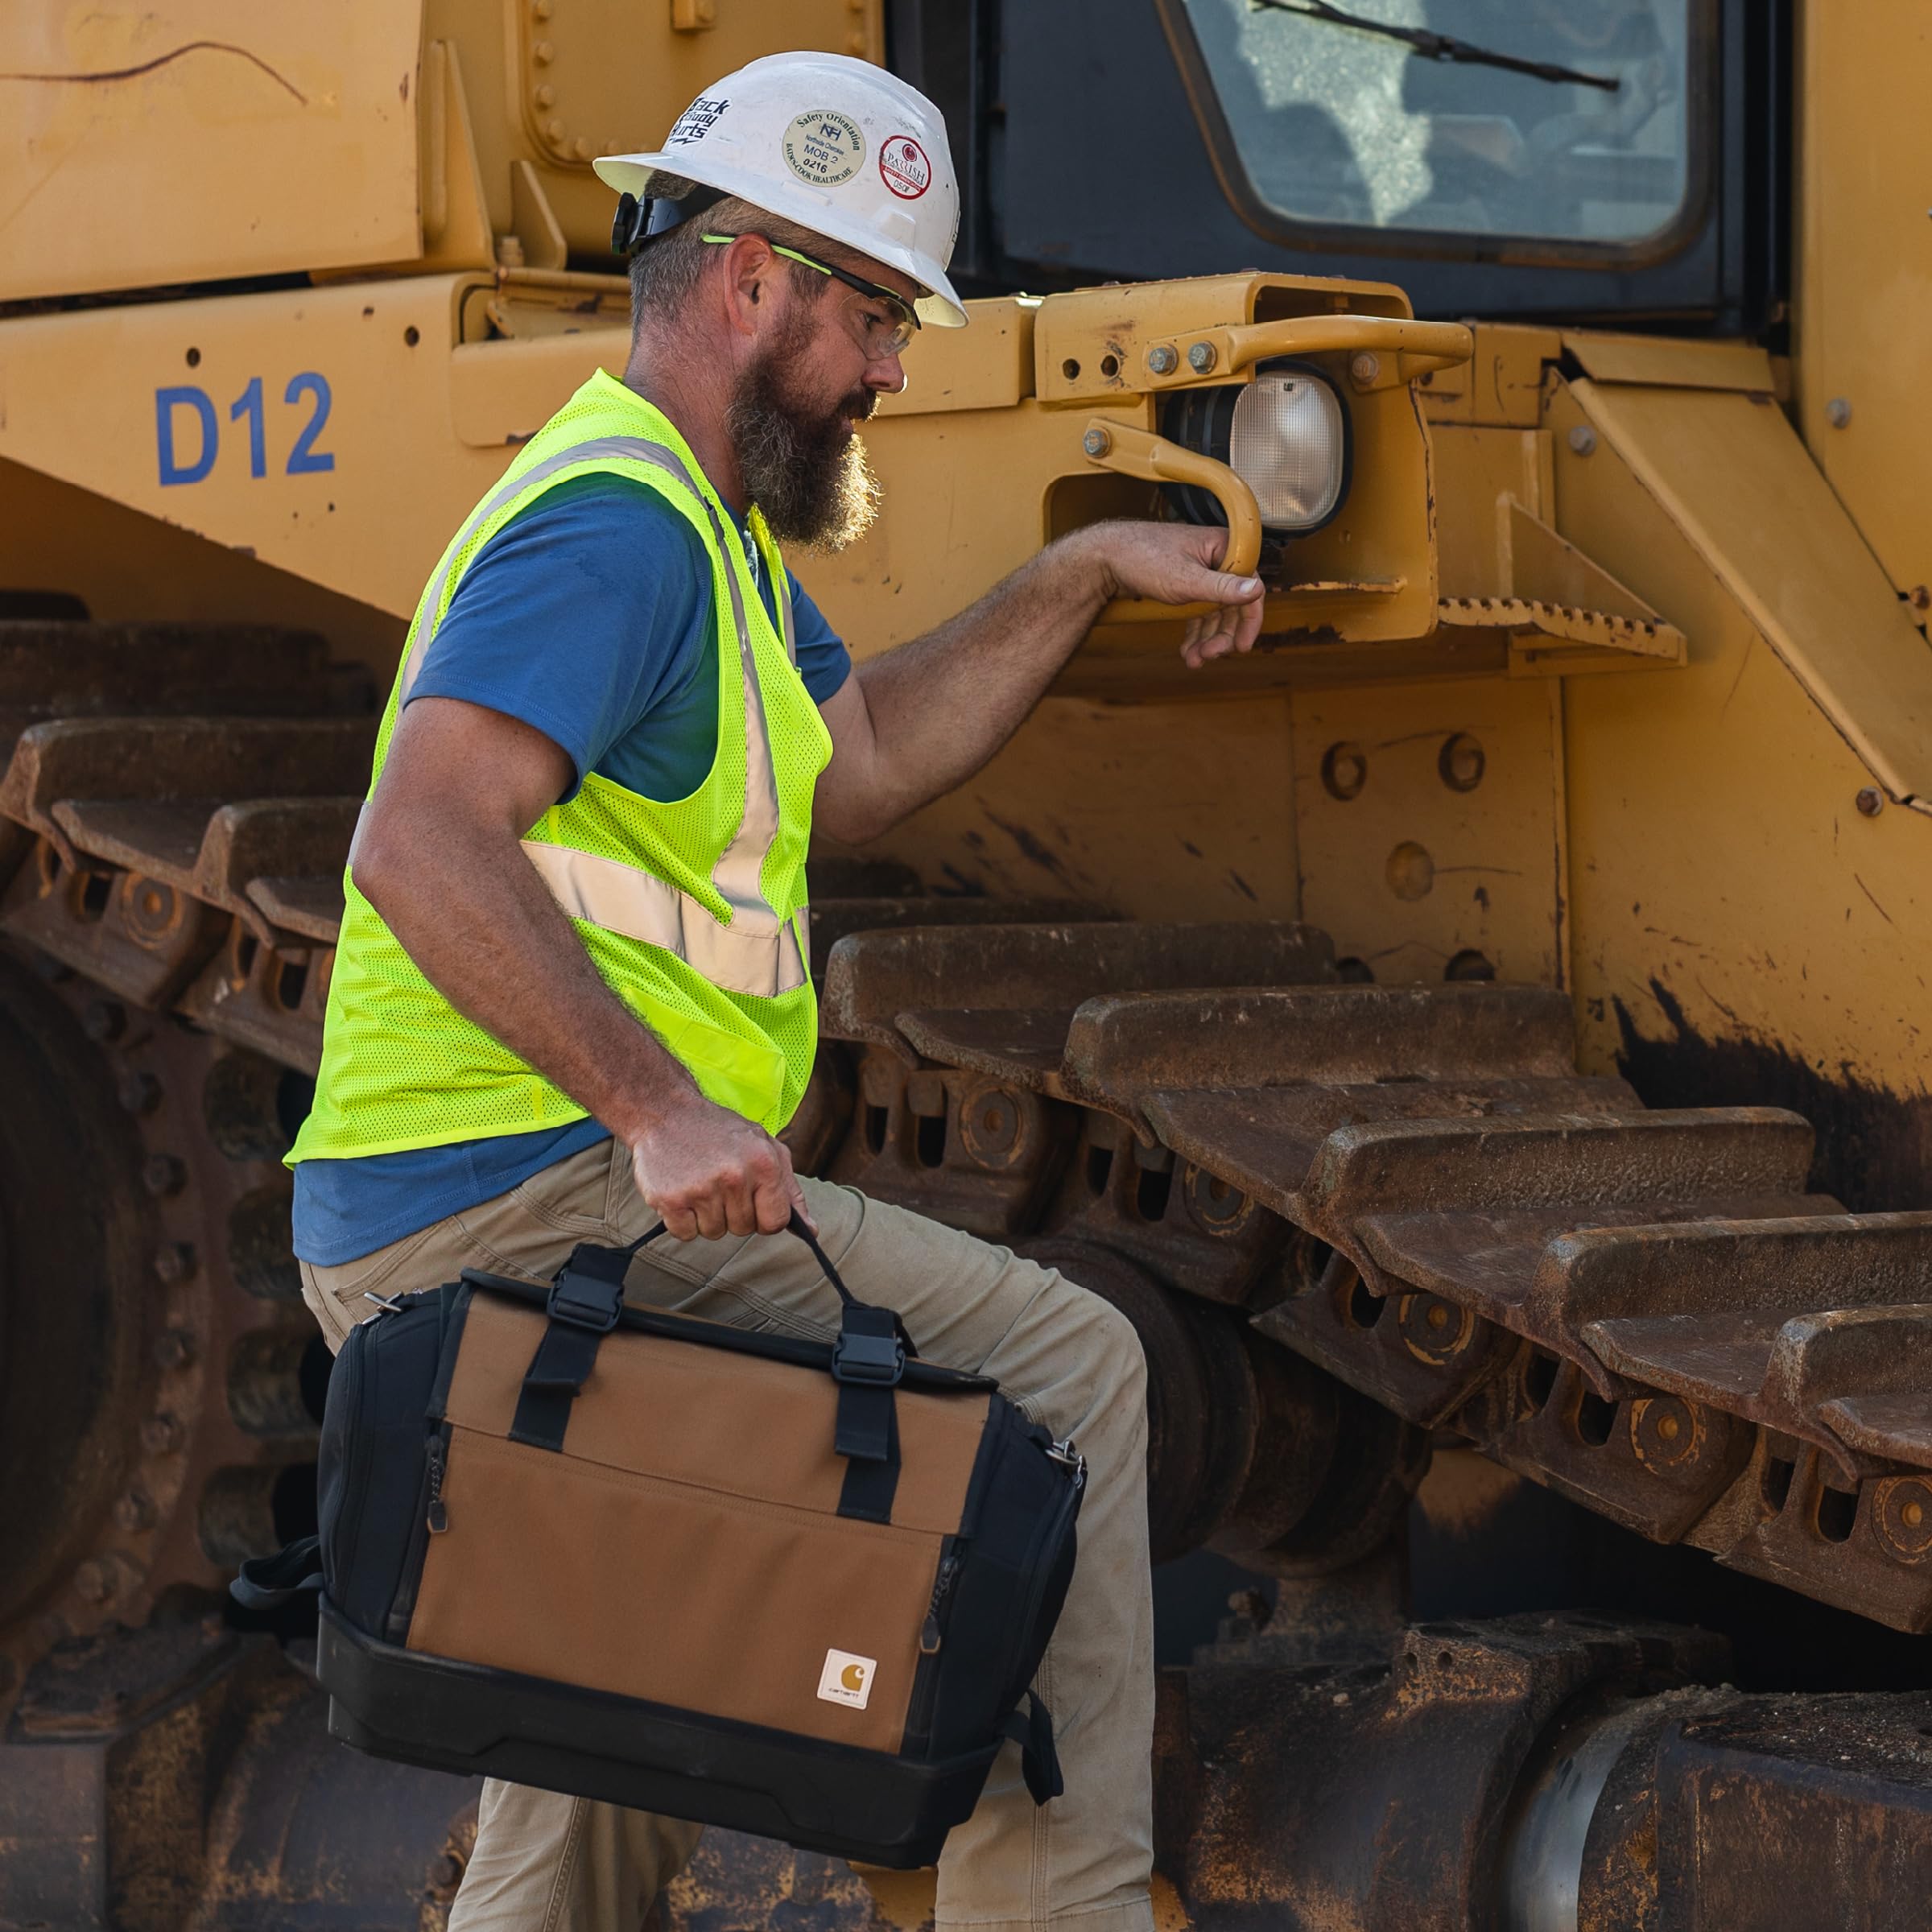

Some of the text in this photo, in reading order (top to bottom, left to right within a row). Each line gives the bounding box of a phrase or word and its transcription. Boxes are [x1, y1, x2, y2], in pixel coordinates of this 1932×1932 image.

[796, 114, 860, 151] Safety Orientation
[803, 144, 839, 164] MOB 2
[803, 158, 828, 173] 0216
[812, 167, 853, 184] HEALTHCARE
[155, 371, 335, 486] D12
